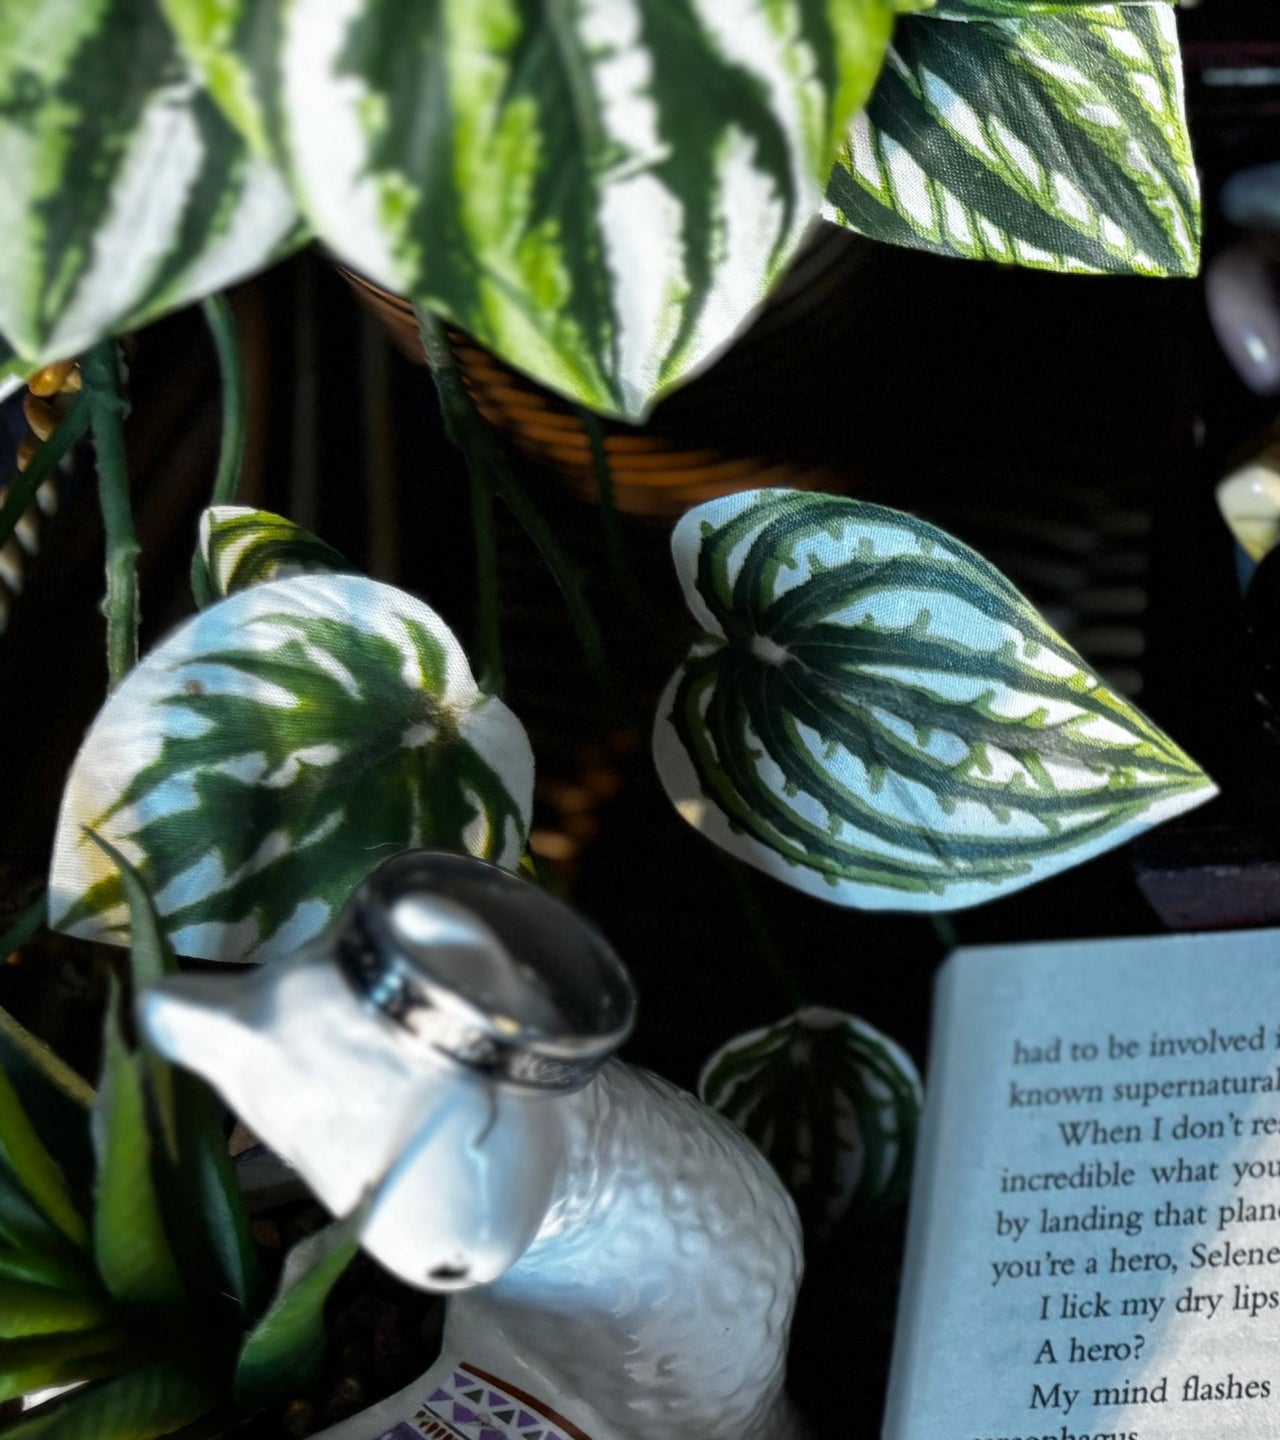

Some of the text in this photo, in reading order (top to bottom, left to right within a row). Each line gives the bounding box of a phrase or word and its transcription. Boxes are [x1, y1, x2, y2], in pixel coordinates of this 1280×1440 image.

[1014, 1039, 1061, 1064] had
[1071, 1044, 1099, 1061] to
[1108, 1035, 1140, 1059] be
[1150, 1025, 1265, 1057] involved
[1058, 1119, 1142, 1146] When
[1152, 1117, 1162, 1142] I
[1171, 1111, 1243, 1141] don’t
[991, 1250, 1076, 1287] you’re
[1084, 1257, 1098, 1275] a
[1108, 1246, 1178, 1274] hero,
[1039, 1294, 1051, 1321] I
[1059, 1291, 1111, 1320] lick
[1120, 1296, 1166, 1323] my
[1174, 1285, 1225, 1321] dry
